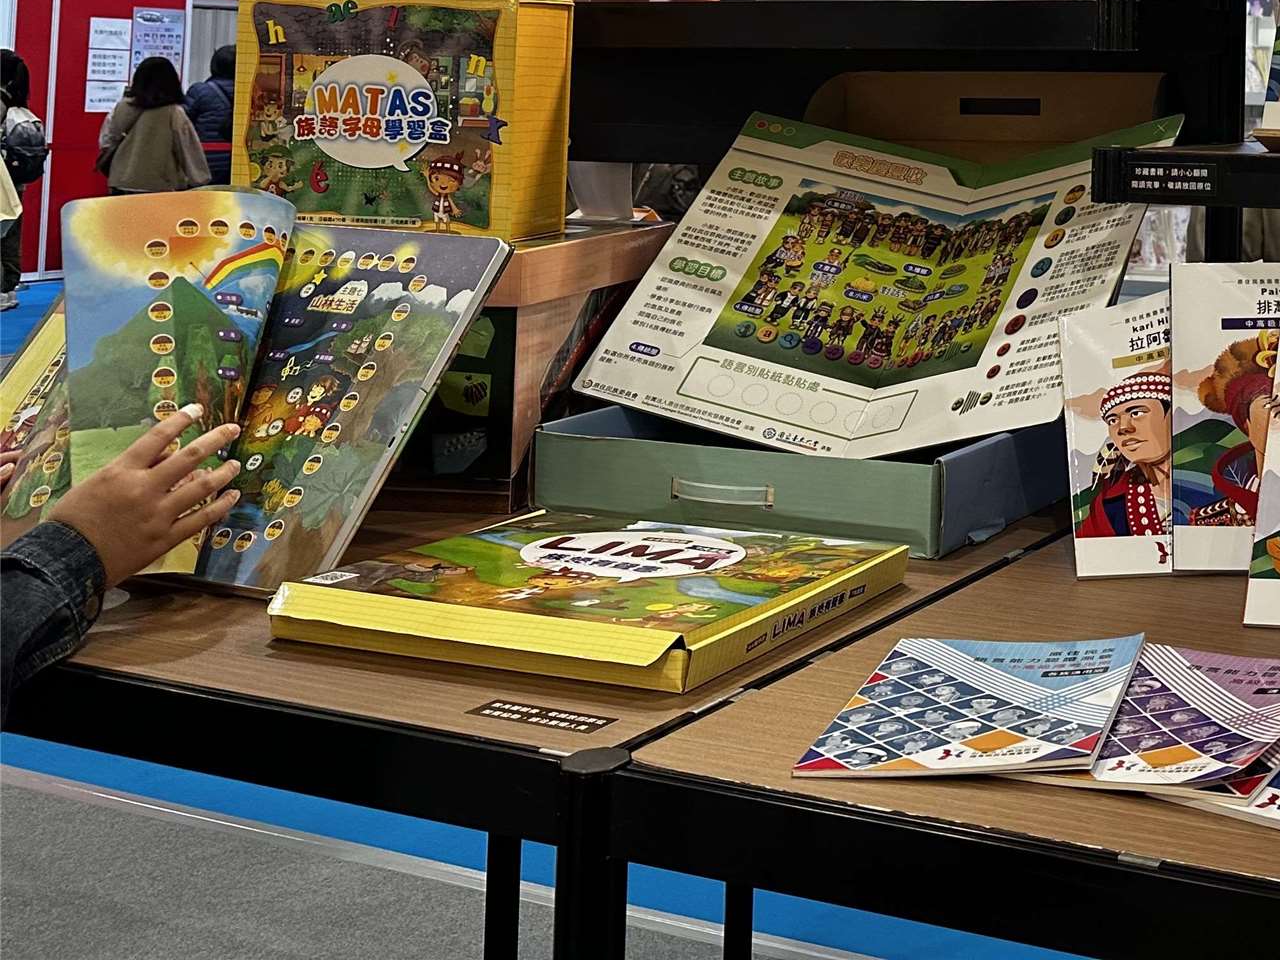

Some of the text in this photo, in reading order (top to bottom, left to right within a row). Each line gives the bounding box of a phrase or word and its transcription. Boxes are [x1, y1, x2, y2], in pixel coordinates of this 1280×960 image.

[467, 54, 489, 77] n
[313, 85, 433, 118] MATAS
[296, 117, 450, 143] 族語字母學習盒
[671, 258, 726, 281] 學習目標
[310, 296, 358, 312] 山林生活
[540, 536, 720, 570] LIMA
[771, 609, 806, 641] LIMA
